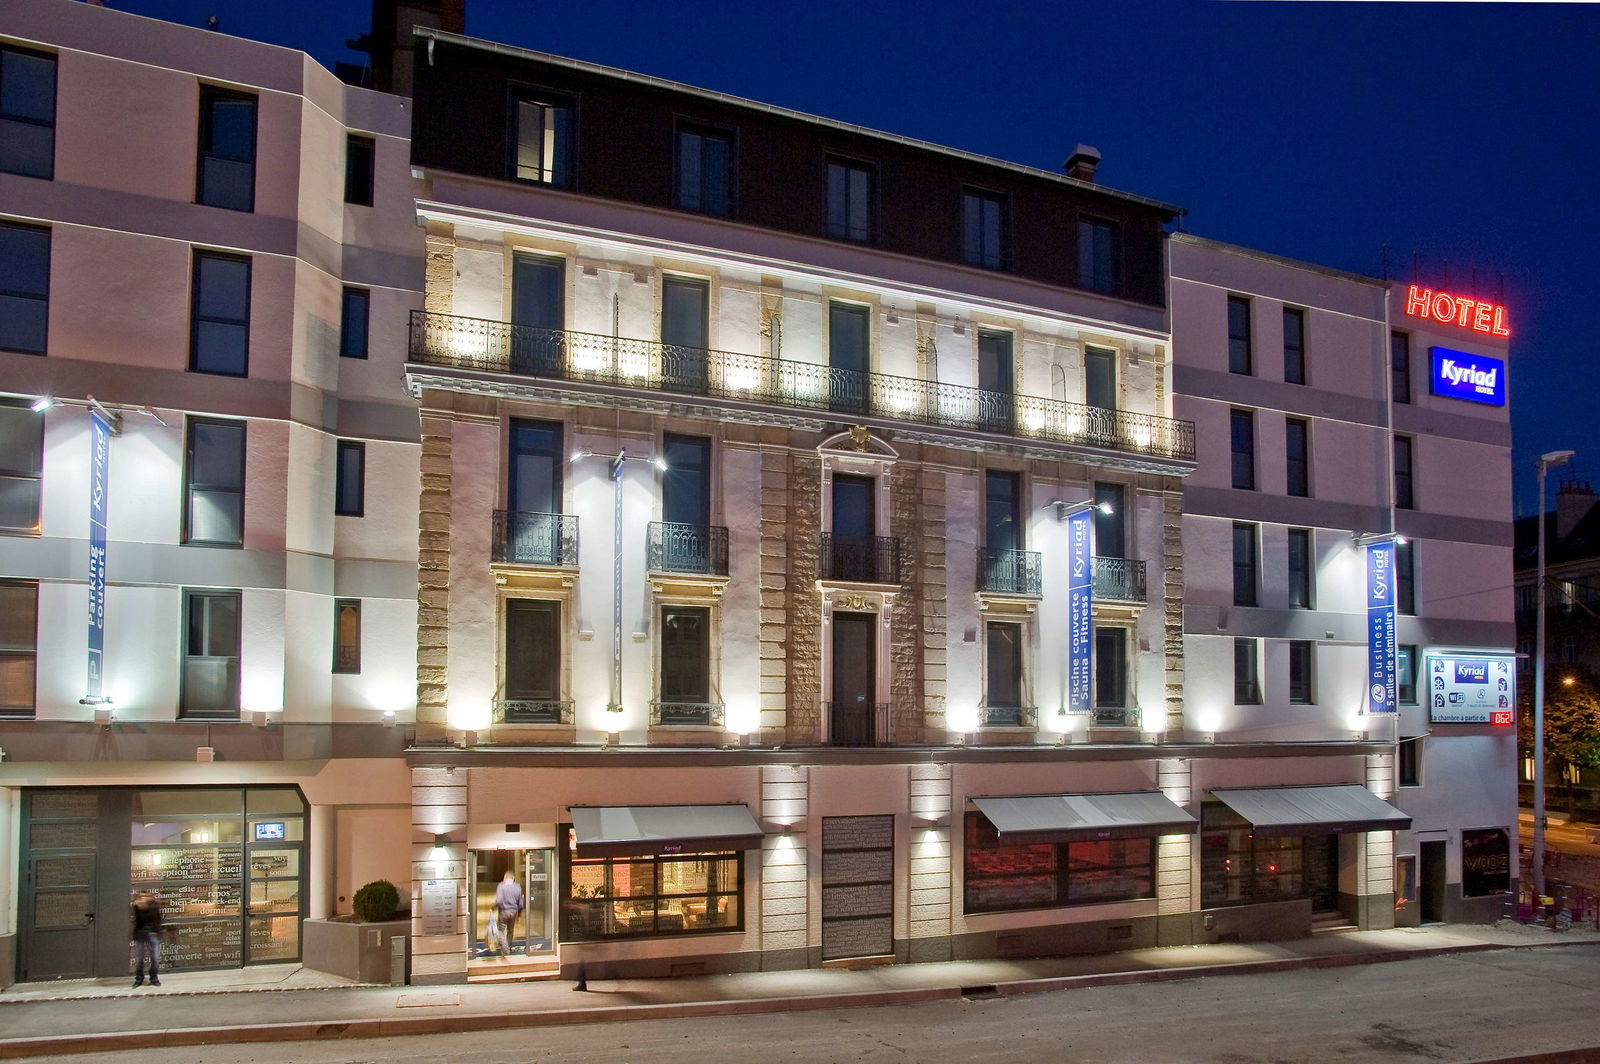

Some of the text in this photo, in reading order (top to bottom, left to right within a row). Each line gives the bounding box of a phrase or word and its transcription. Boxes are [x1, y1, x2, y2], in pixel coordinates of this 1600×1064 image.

[1407, 285, 1510, 336] HOTEL
[1441, 358, 1497, 387] Kyriad
[93, 423, 105, 511] Kyriad
[1072, 519, 1086, 578] Kyriad
[88, 545, 98, 626] Parking
[97, 547, 105, 630] couvert
[1373, 549, 1388, 599] Kyriad
[1080, 595, 1089, 643] Fitness
[1384, 611, 1394, 658] séminaire
[1071, 592, 1080, 706] Piscine couverte
[1373, 617, 1383, 678] Business
[1080, 657, 1089, 700] Sauna
[1385, 660, 1394, 672] de
[1457, 664, 1485, 677] Kyriad
[1385, 673, 1395, 699] salles
[1437, 713, 1460, 721] chambre
[1464, 714, 1479, 722] partir
[131, 870, 147, 878] wifi
[209, 864, 242, 873] accueil
[208, 890, 231, 898] repos
[178, 927, 203, 935] parking
[164, 952, 203, 961] couverte
[223, 950, 241, 959] wifi
